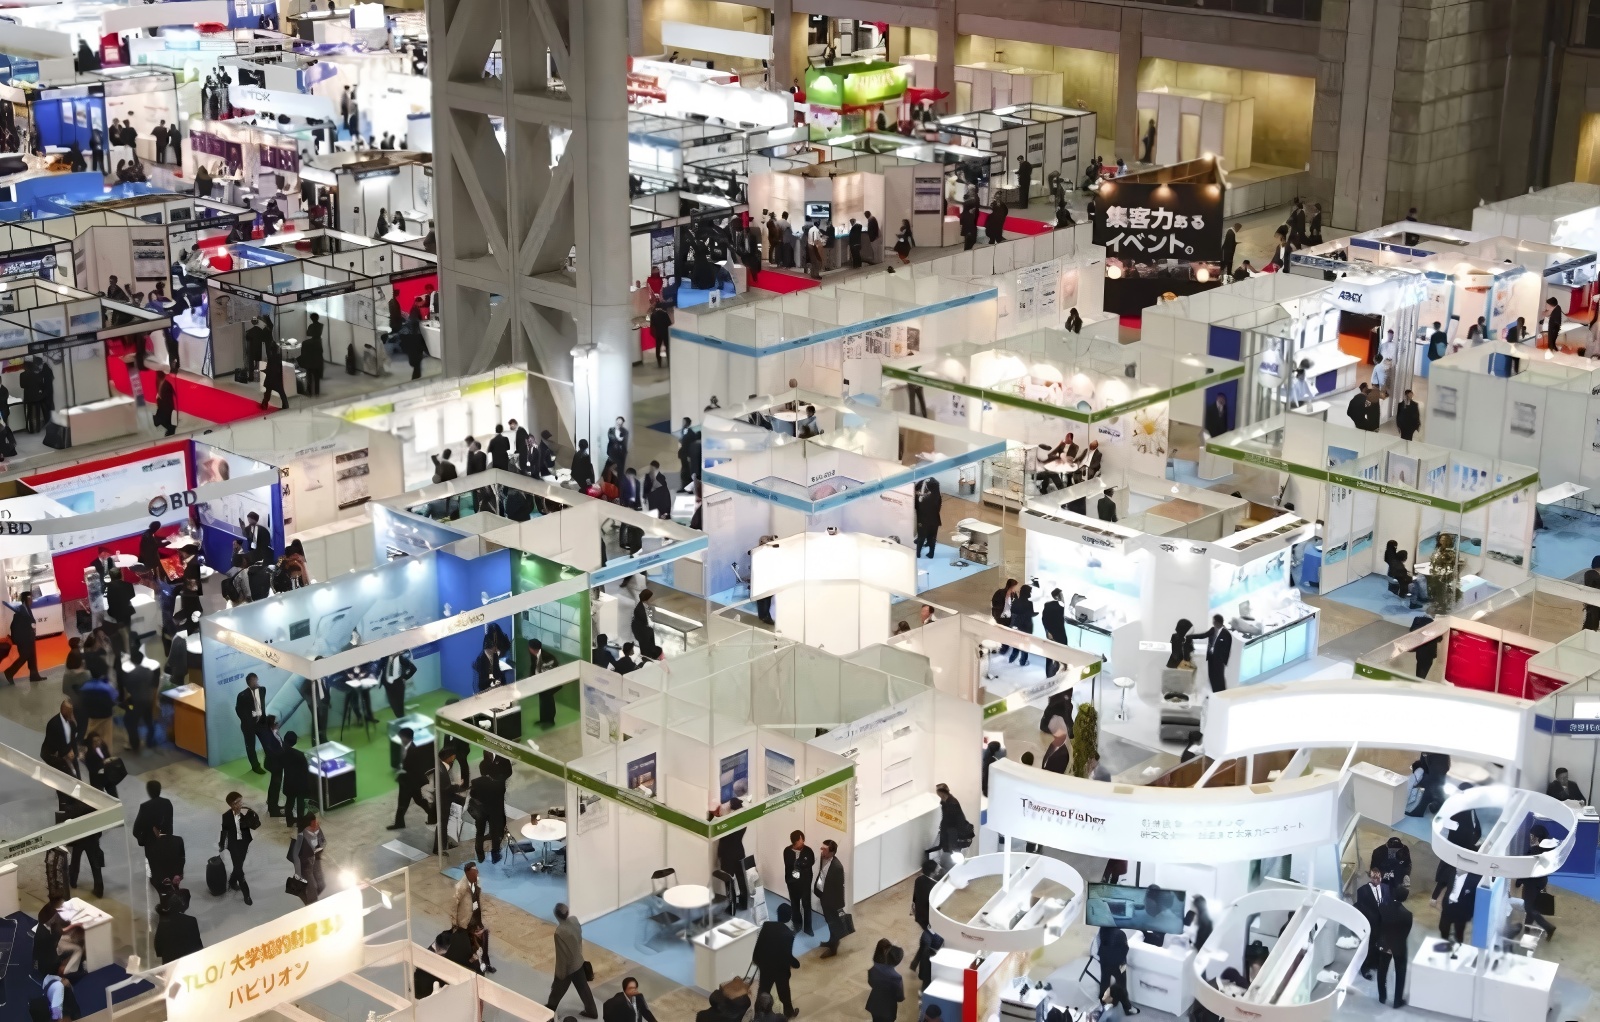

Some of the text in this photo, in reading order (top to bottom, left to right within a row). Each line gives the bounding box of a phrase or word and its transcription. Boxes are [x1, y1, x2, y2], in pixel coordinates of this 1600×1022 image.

[1105, 205, 1205, 230] 集客力ある
[1105, 232, 1195, 254] イベント。
[170, 490, 198, 511] BD
[7, 521, 33, 535] BD
